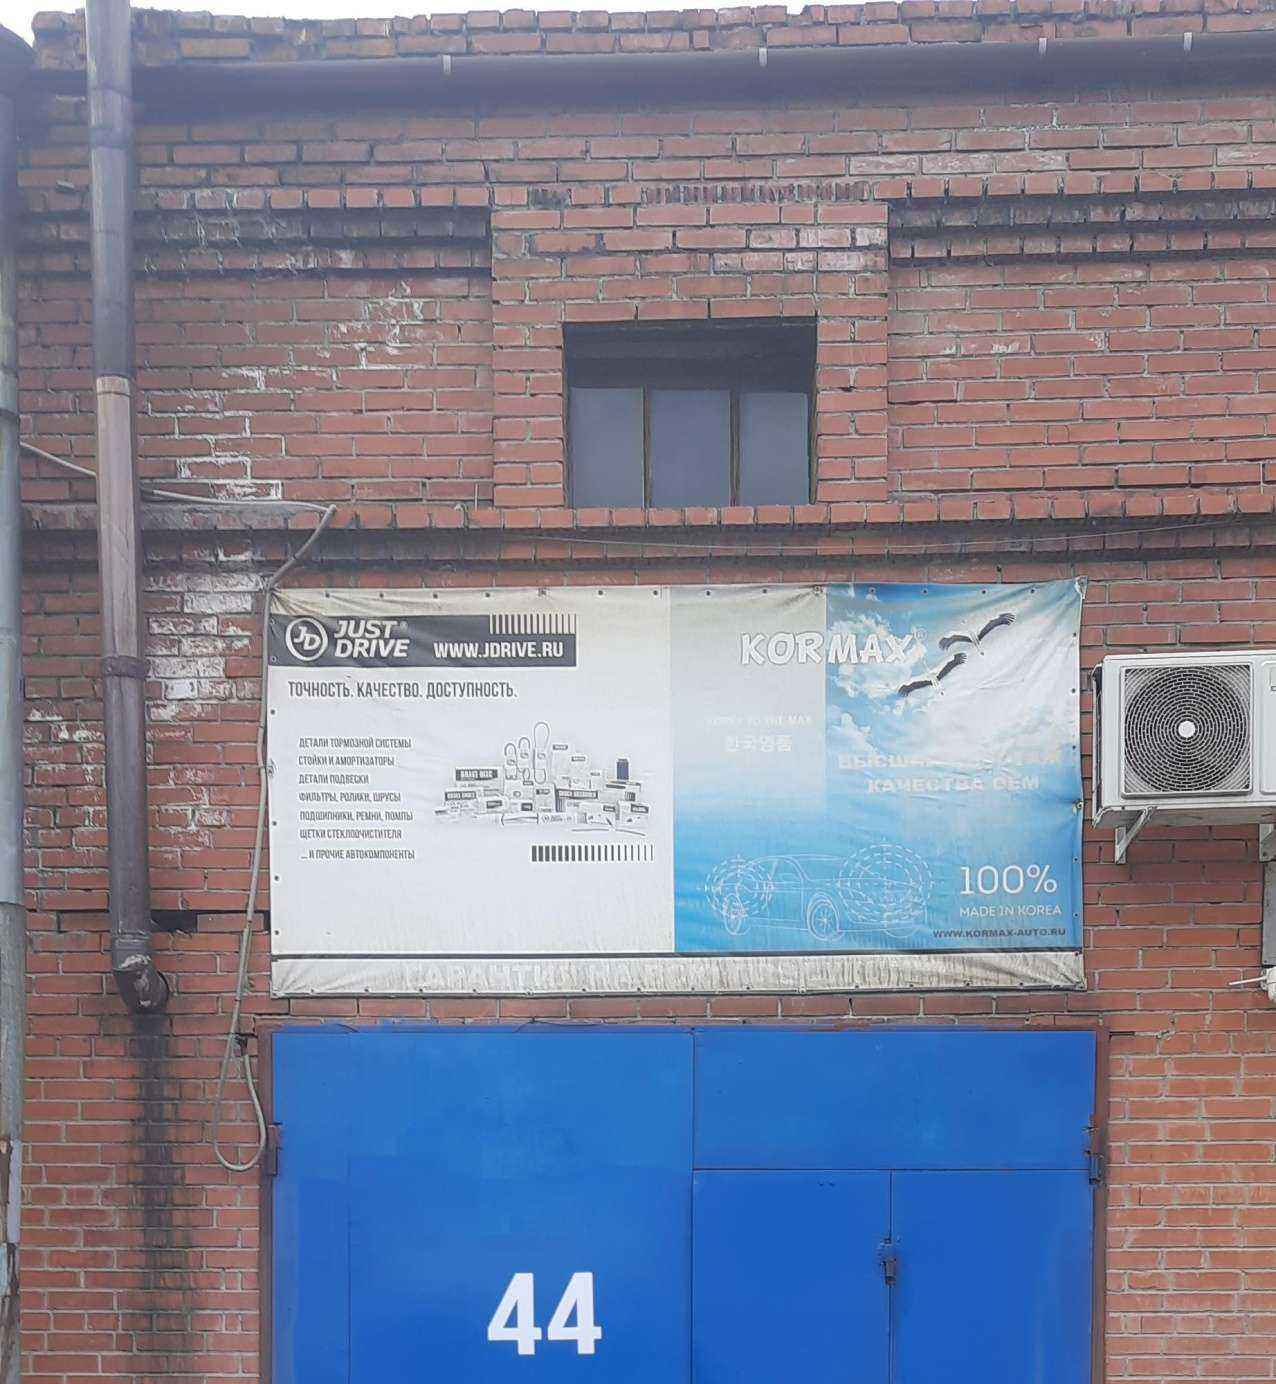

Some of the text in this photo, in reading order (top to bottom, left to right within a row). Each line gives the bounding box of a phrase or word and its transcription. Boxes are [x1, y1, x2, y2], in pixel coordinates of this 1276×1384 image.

[334, 619, 398, 639] JUST
[334, 639, 410, 658] DRIVE
[433, 640, 564, 659] WWW.JDRIVE.RU
[740, 630, 913, 666] KORMAX
[287, 680, 518, 700] ТОЧНОСТЬ. КАЧЕСТВО. ДОСТУПНОСТЬ.
[299, 736, 412, 749] ДЕТАЛИ ТОРМОЗНОЙ СИСТЕМЫ
[299, 754, 327, 766] СТОЙКИ
[335, 756, 395, 766] АМОРТИЗАТОРЫ
[299, 774, 370, 785] ДЕТАЛИ ПОДВЕСКИ
[299, 829, 326, 840] ЩЕТКИ
[315, 849, 345, 860] ПРОЧИЕ
[346, 849, 415, 860] АВТОКОМПОНЕНТЫ
[960, 864, 1058, 895] 100%
[960, 904, 1062, 918] MADE IN KOREA
[933, 928, 1066, 939] WWW.KORMAX-AUTO.RU
[487, 1271, 603, 1356] 44
